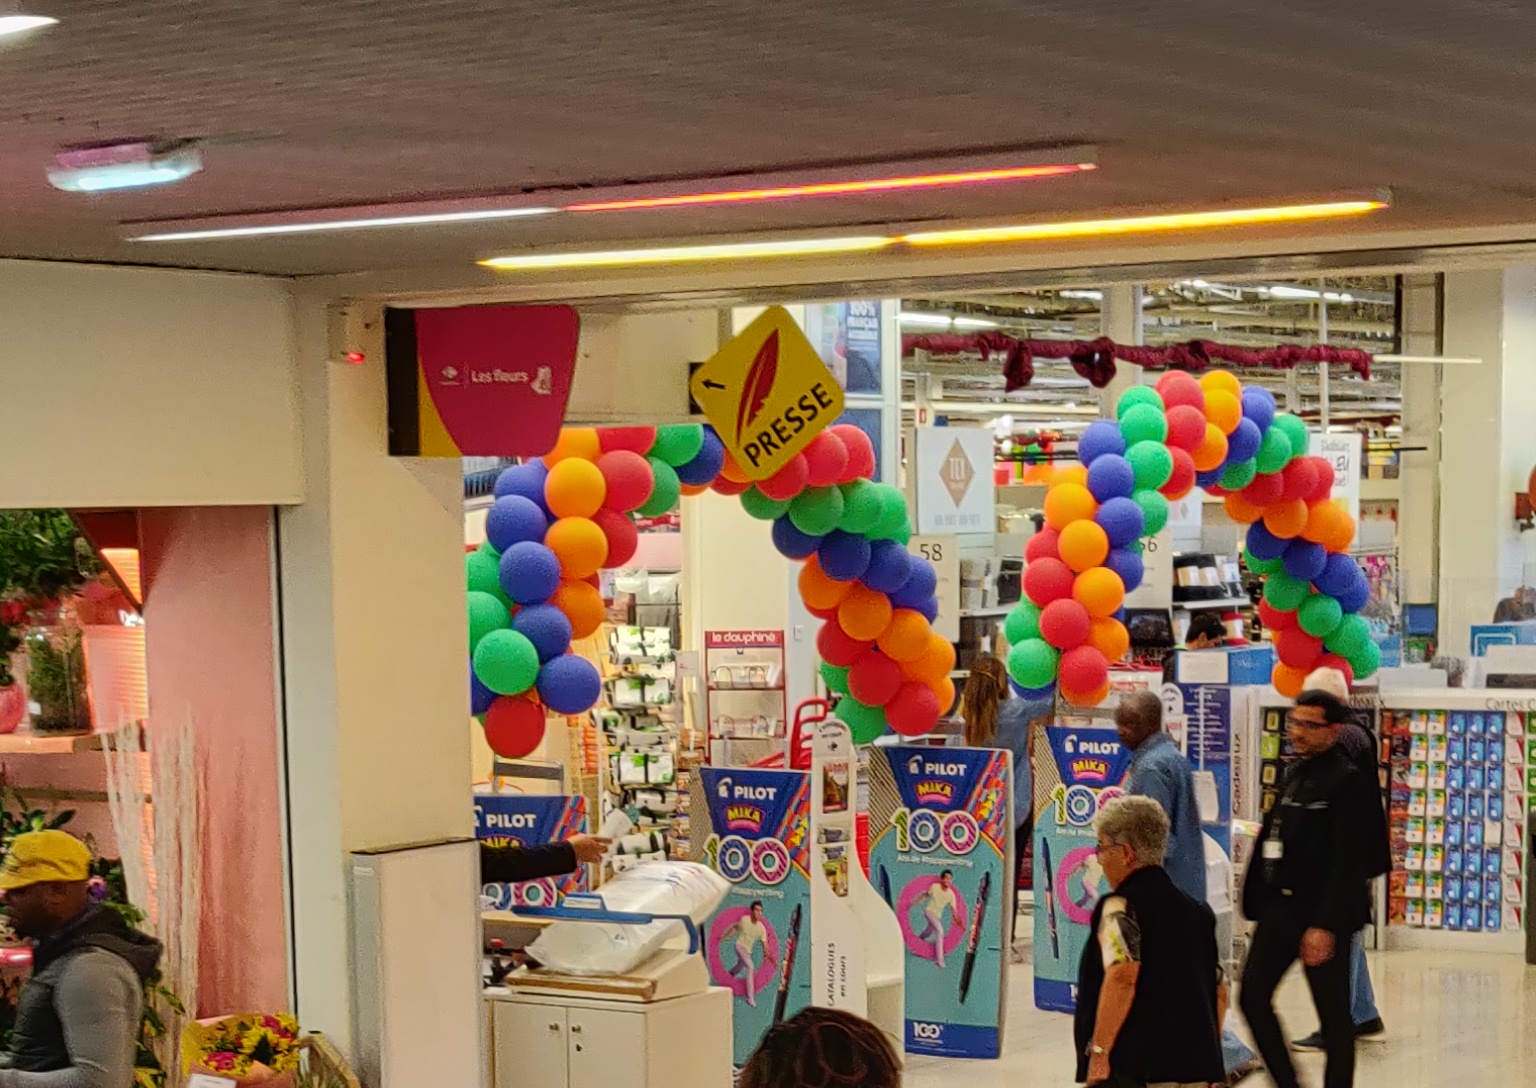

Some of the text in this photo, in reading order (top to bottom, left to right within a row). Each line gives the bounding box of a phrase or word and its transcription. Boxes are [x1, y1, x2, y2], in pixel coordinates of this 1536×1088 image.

[743, 383, 833, 468] PRESSE
[920, 543, 943, 561] 58
[712, 631, 776, 645] le dauphiné
[1079, 742, 1121, 755] PILOT
[925, 763, 967, 776] PILOT
[1073, 759, 1107, 773] MIKA
[734, 786, 777, 800] PILOT
[917, 782, 952, 797] MIKA
[1051, 783, 1125, 826] 10
[486, 813, 537, 828] PILOT
[727, 806, 761, 823] MIKA
[889, 807, 980, 855] 100
[703, 832, 791, 885] 100
[827, 943, 836, 1007] CATALOGUES
